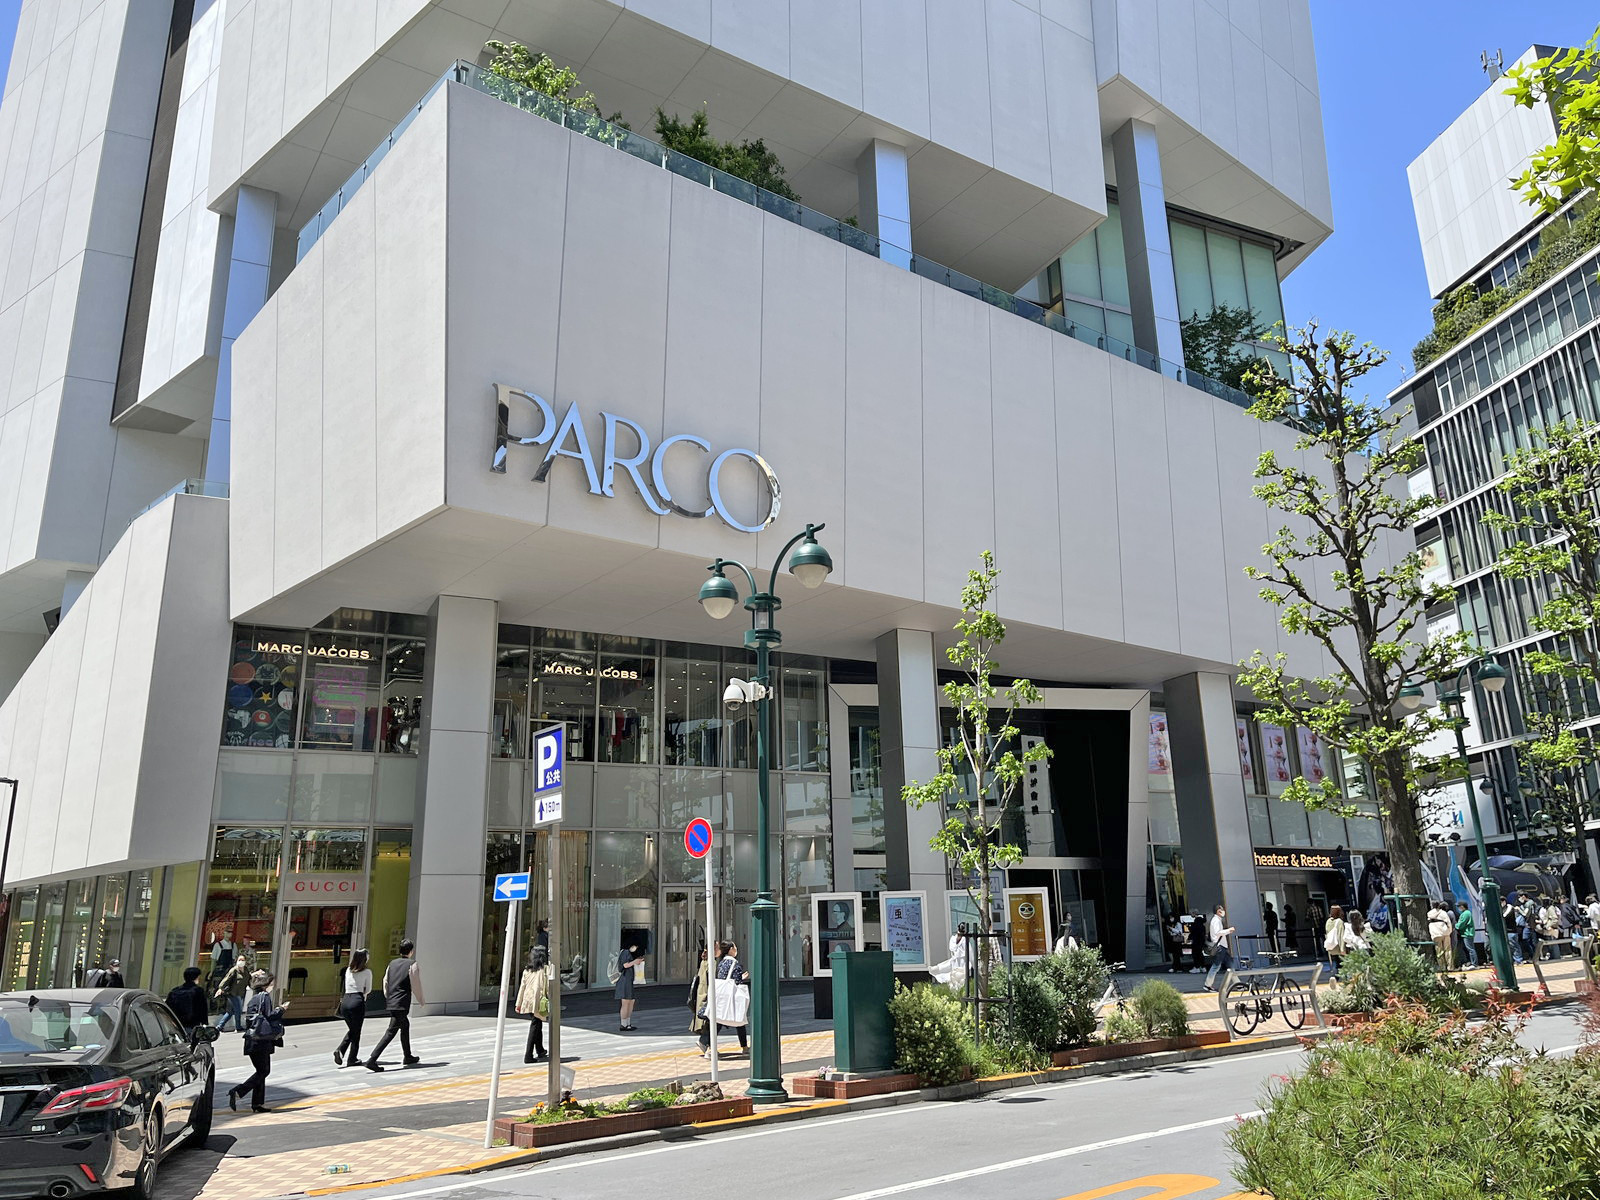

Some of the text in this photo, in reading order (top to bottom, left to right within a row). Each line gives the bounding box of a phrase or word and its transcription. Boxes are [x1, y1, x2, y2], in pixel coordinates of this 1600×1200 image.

[490, 382, 782, 533] PARCO
[257, 642, 370, 660] MARC JACOBS
[543, 664, 582, 675] MARC
[537, 735, 558, 789] P
[545, 768, 561, 786] 公共
[545, 800, 560, 814] 150m
[1291, 853, 1300, 868] &
[294, 881, 357, 893] GUCCI
